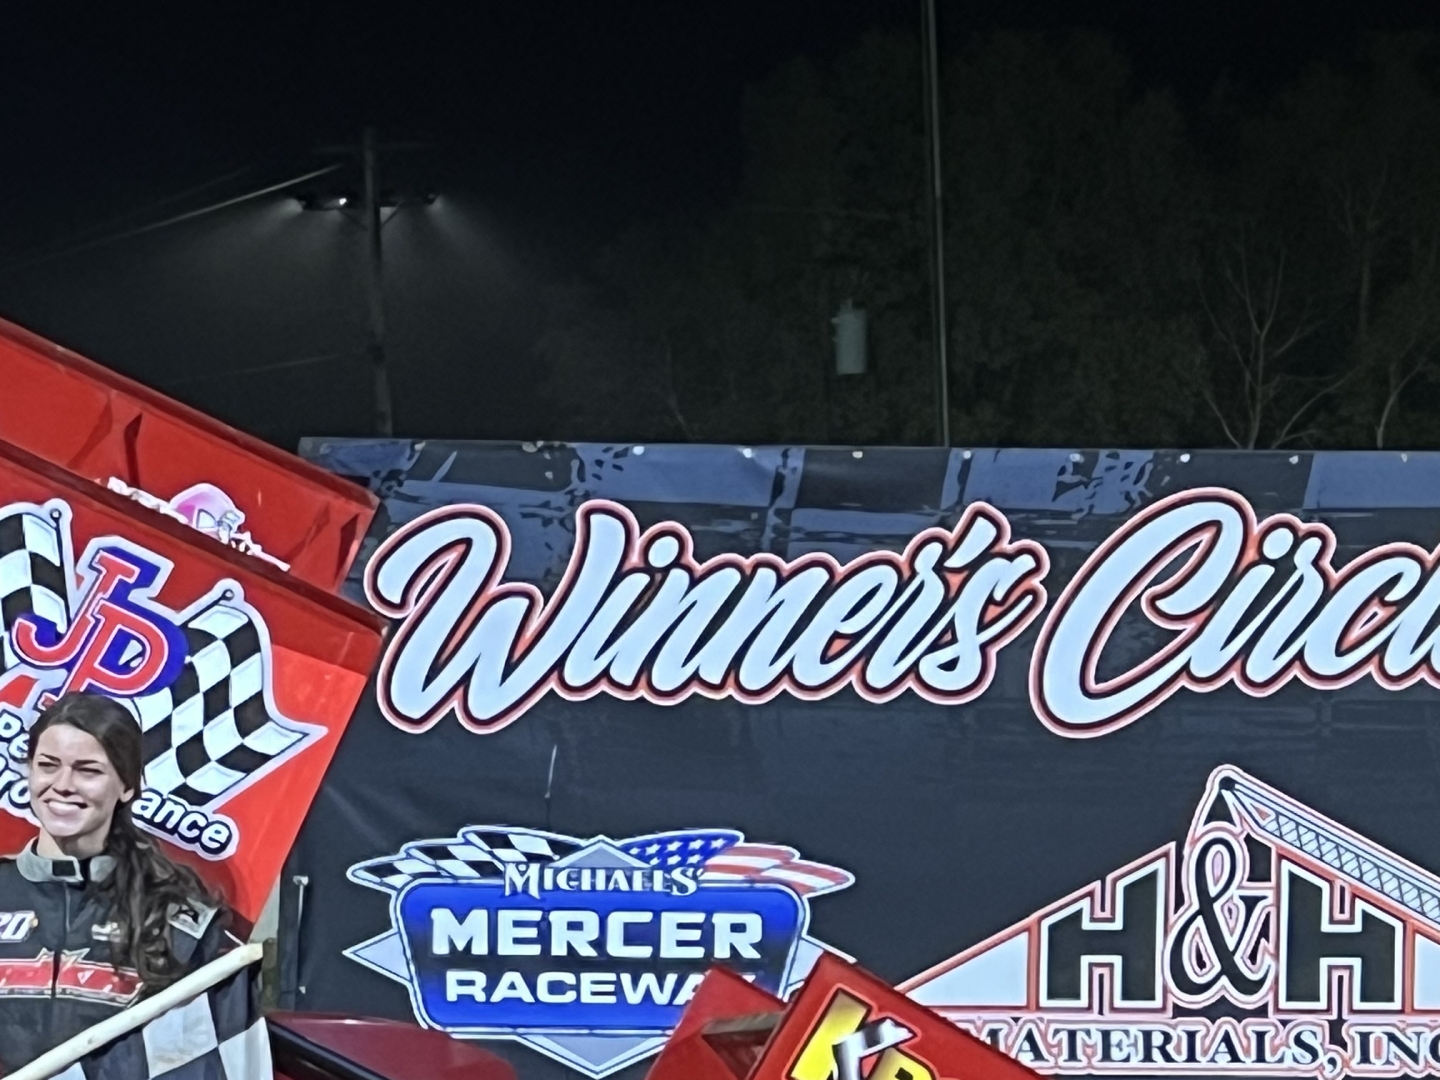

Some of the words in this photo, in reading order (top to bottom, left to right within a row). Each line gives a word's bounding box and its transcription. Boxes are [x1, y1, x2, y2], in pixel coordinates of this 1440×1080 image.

[371, 505, 1045, 729] Winner's
[1039, 499, 1440, 729] Circl
[431, 907, 763, 959] MERCER
[1040, 836, 1404, 1010] H&H
[445, 970, 750, 1006] RACEWA
